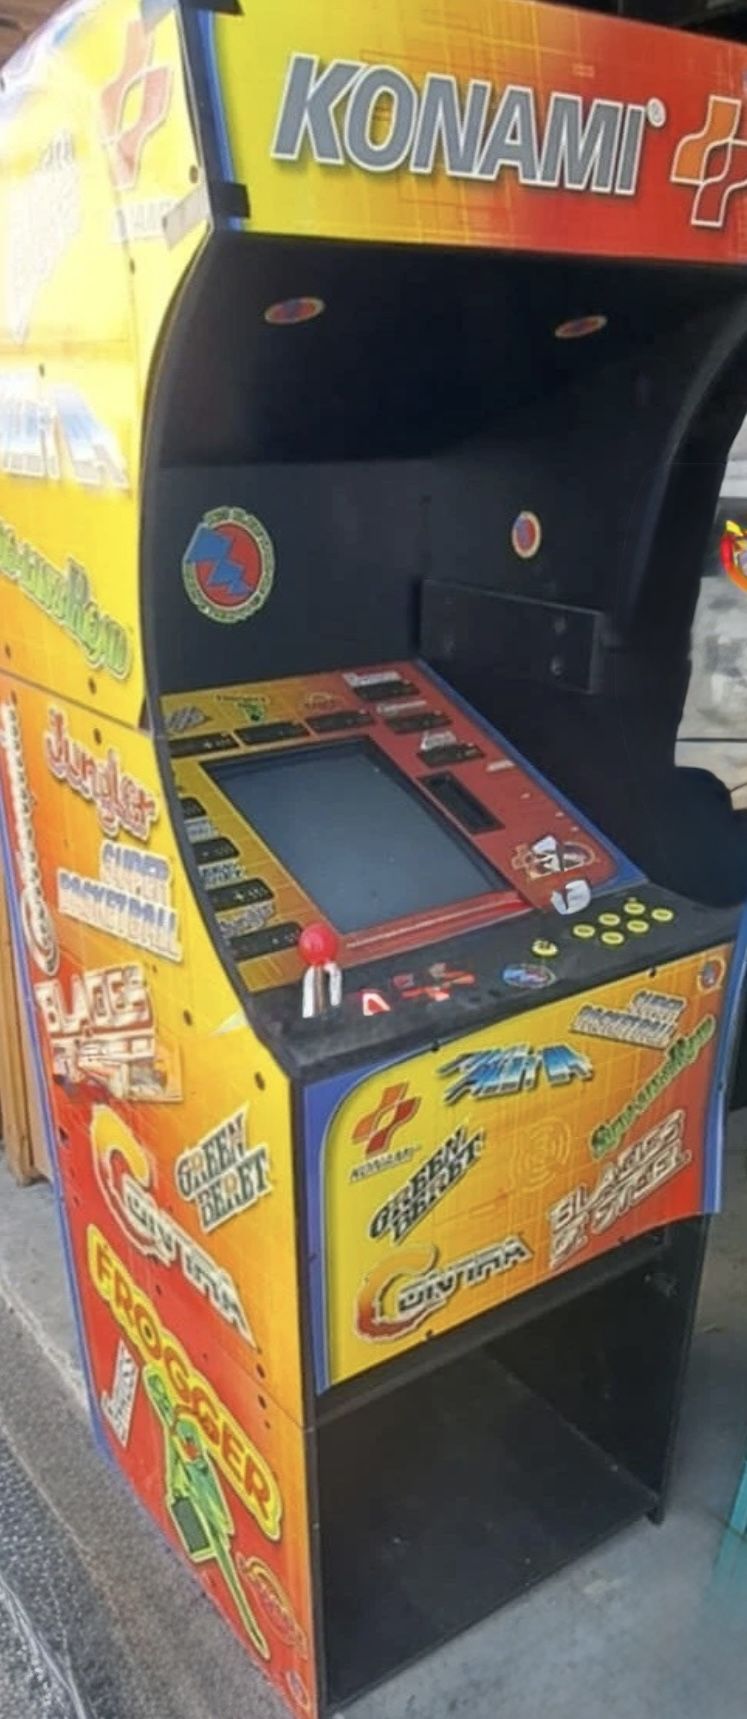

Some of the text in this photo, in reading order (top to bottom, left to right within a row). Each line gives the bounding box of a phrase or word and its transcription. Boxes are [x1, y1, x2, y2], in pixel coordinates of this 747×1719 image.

[45, 704, 158, 841] Jungler
[177, 1104, 248, 1200] GREEN
[198, 1144, 271, 1231] BERET
[90, 1230, 278, 1532] FROGGER
